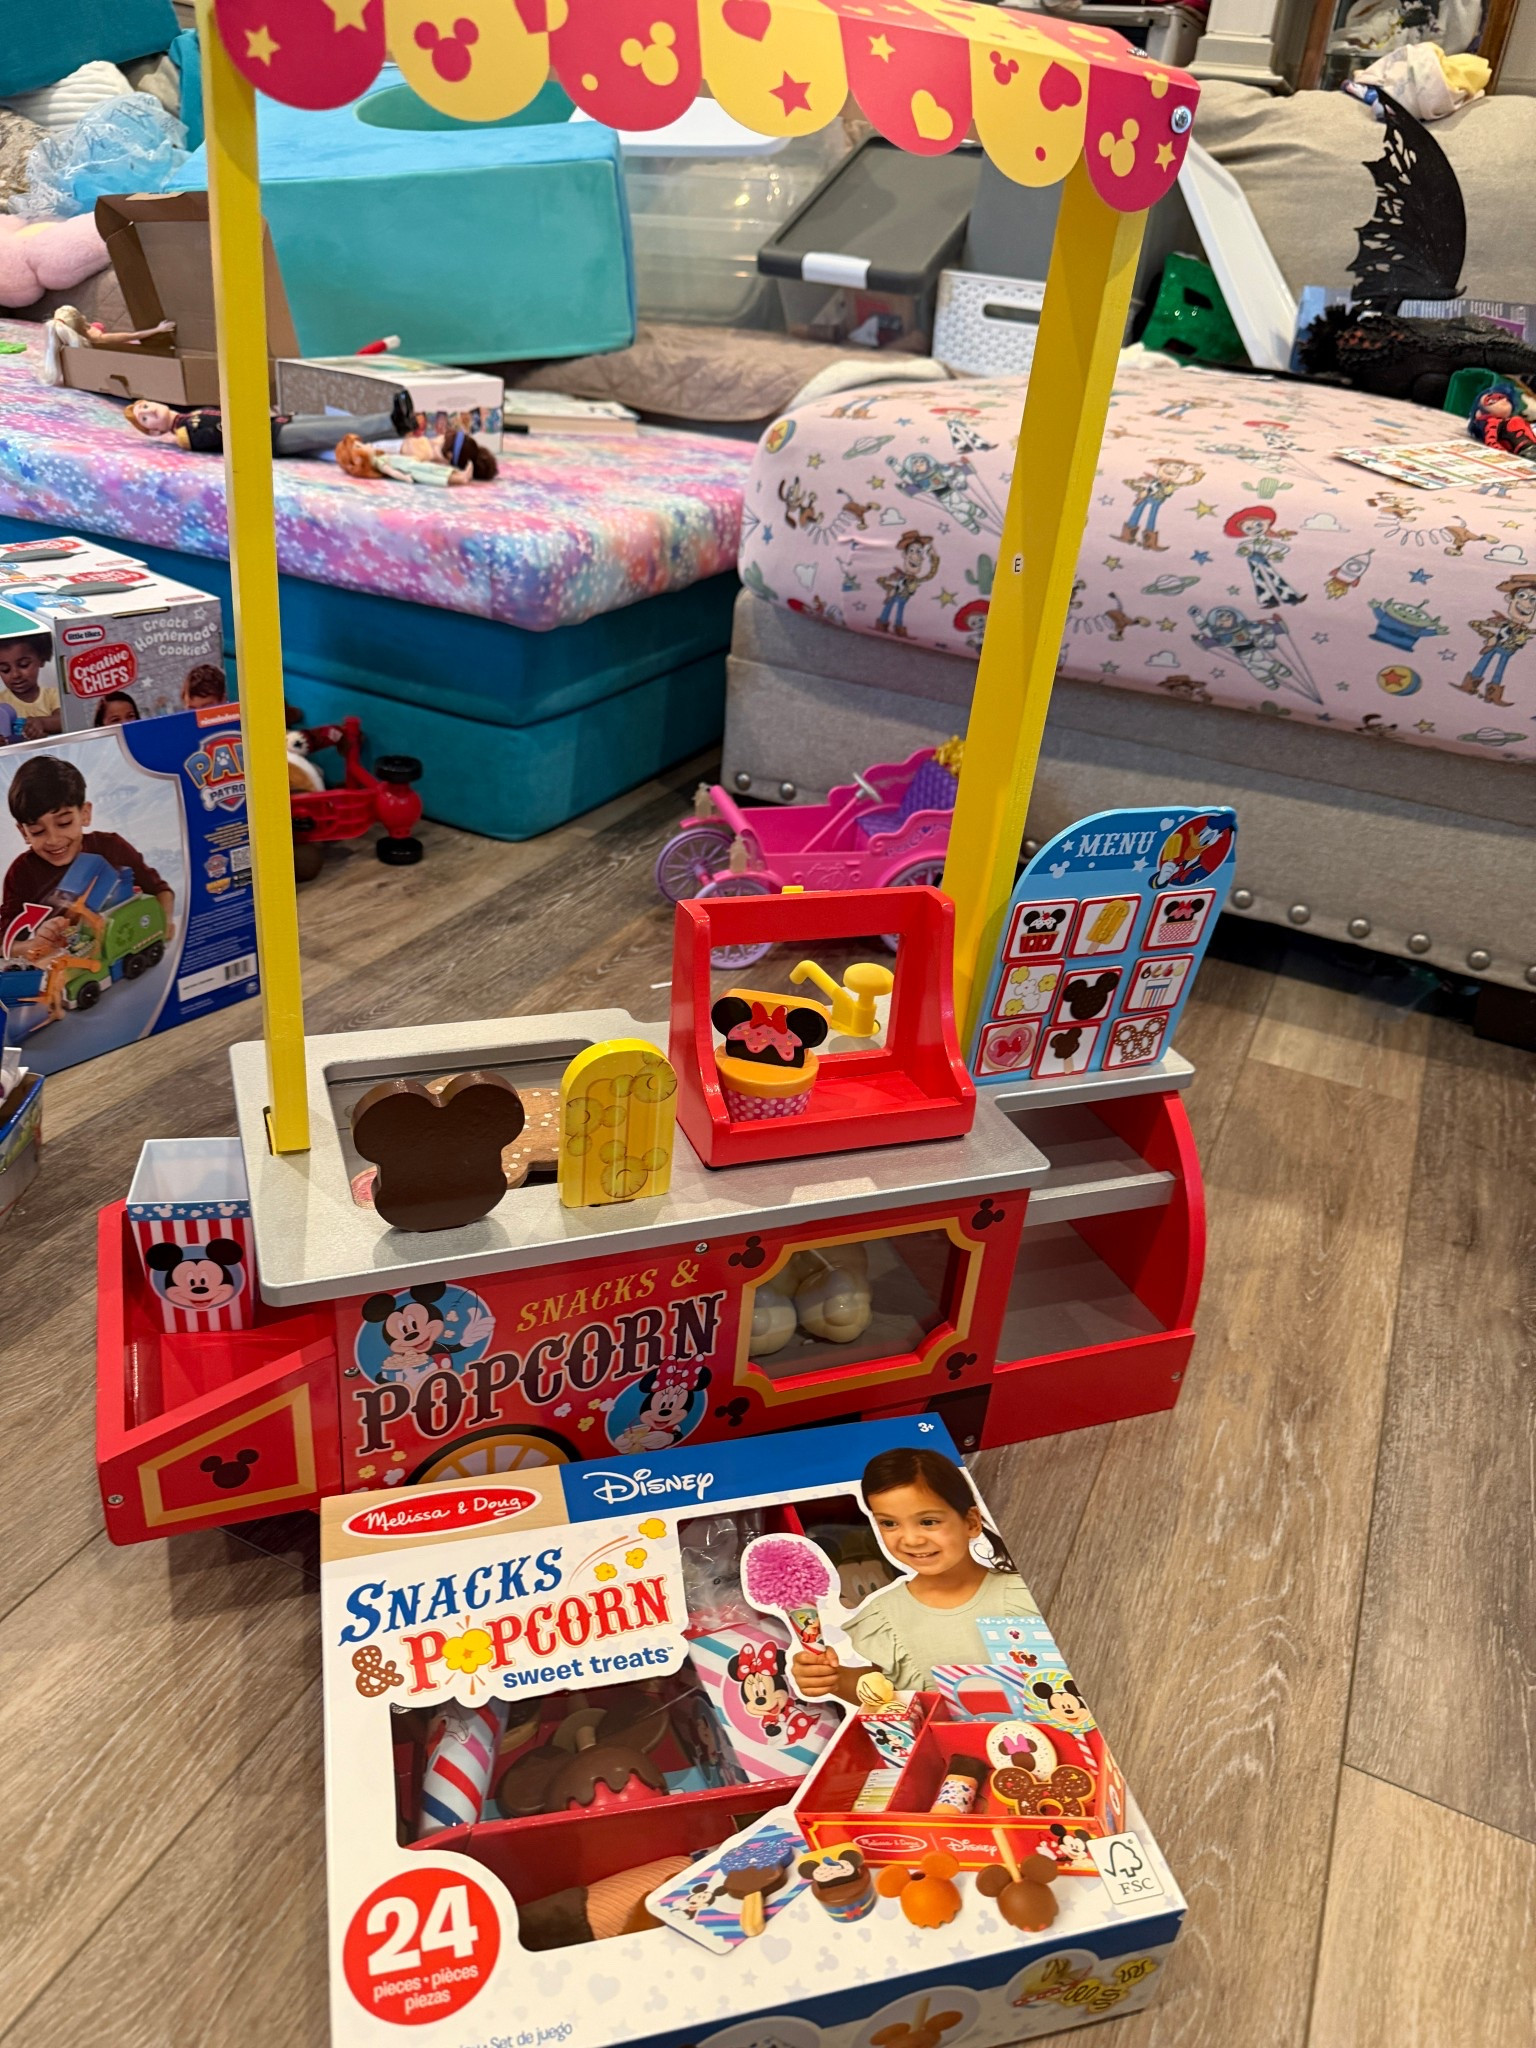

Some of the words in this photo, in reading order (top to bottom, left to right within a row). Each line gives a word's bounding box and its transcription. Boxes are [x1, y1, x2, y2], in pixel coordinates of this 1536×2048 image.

[1014, 558, 1021, 572] E
[68, 632, 83, 640] little
[134, 622, 218, 652] Homemade
[143, 617, 189, 632] Create
[159, 641, 212, 656] Cookies!
[74, 650, 129, 680] Creative
[82, 666, 129, 693] CHEFS
[209, 784, 246, 801] PATRO
[1075, 831, 1156, 859] MENU
[516, 1268, 660, 1333] SNACKS
[671, 1259, 701, 1288] &
[355, 1290, 728, 1457] POPCORN
[917, 1421, 935, 1433] 3+
[363, 1509, 451, 1531] Melissa
[457, 1501, 468, 1514] &
[473, 1497, 522, 1517] Doug
[337, 1546, 564, 1647] SNACKS
[503, 1660, 584, 1689] sweet
[1118, 1877, 1154, 1896] FSC
[365, 1884, 479, 1976] 24
[372, 1975, 422, 2003] pieces
[431, 1965, 479, 1990] pièces
[404, 1990, 451, 2016] piezas
[516, 2030, 534, 2046] de
[536, 2021, 573, 2046] juego
